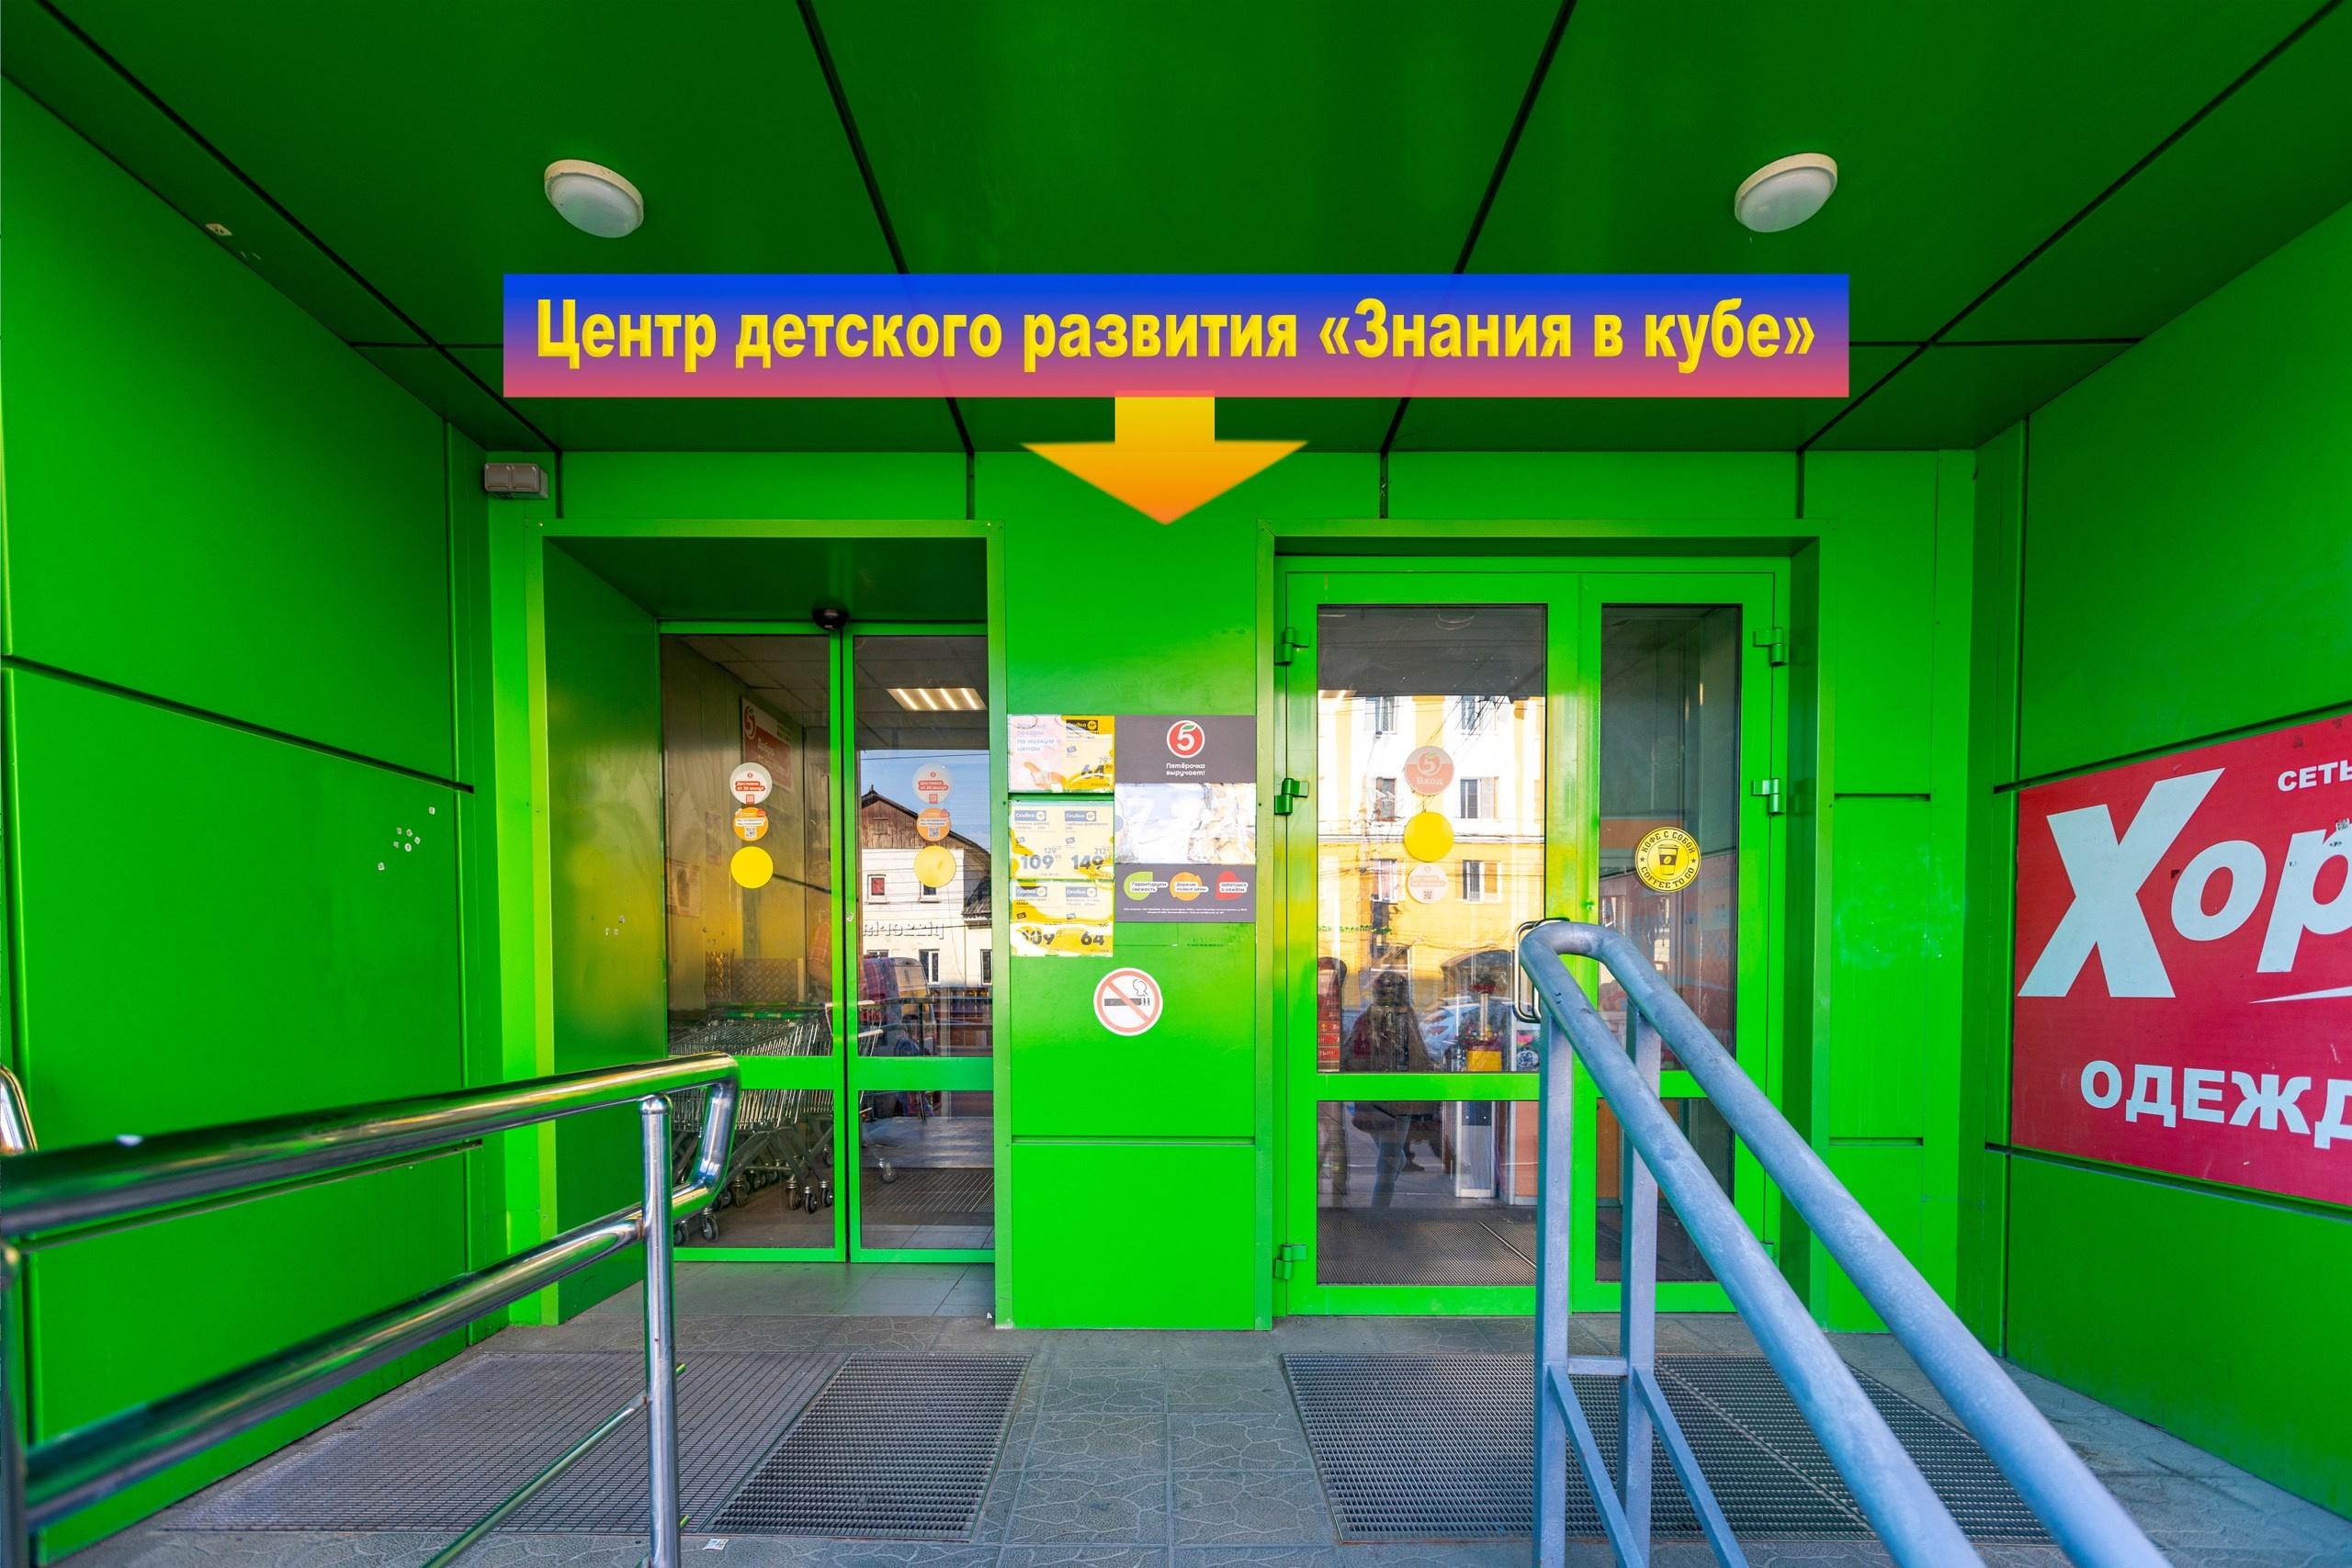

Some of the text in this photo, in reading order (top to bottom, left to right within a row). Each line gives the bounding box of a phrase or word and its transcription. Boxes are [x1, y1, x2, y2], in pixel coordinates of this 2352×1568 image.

[1417, 776, 1443, 785] Вход
[1641, 832, 1661, 852] КОФЕ
[1021, 854, 1054, 869] 109
[1071, 854, 1103, 870] 149
[1641, 866, 1695, 889] COFFEE TO GO
[1080, 931, 1105, 945] 64
[2080, 1059, 2352, 1148] ОДЕЖД
